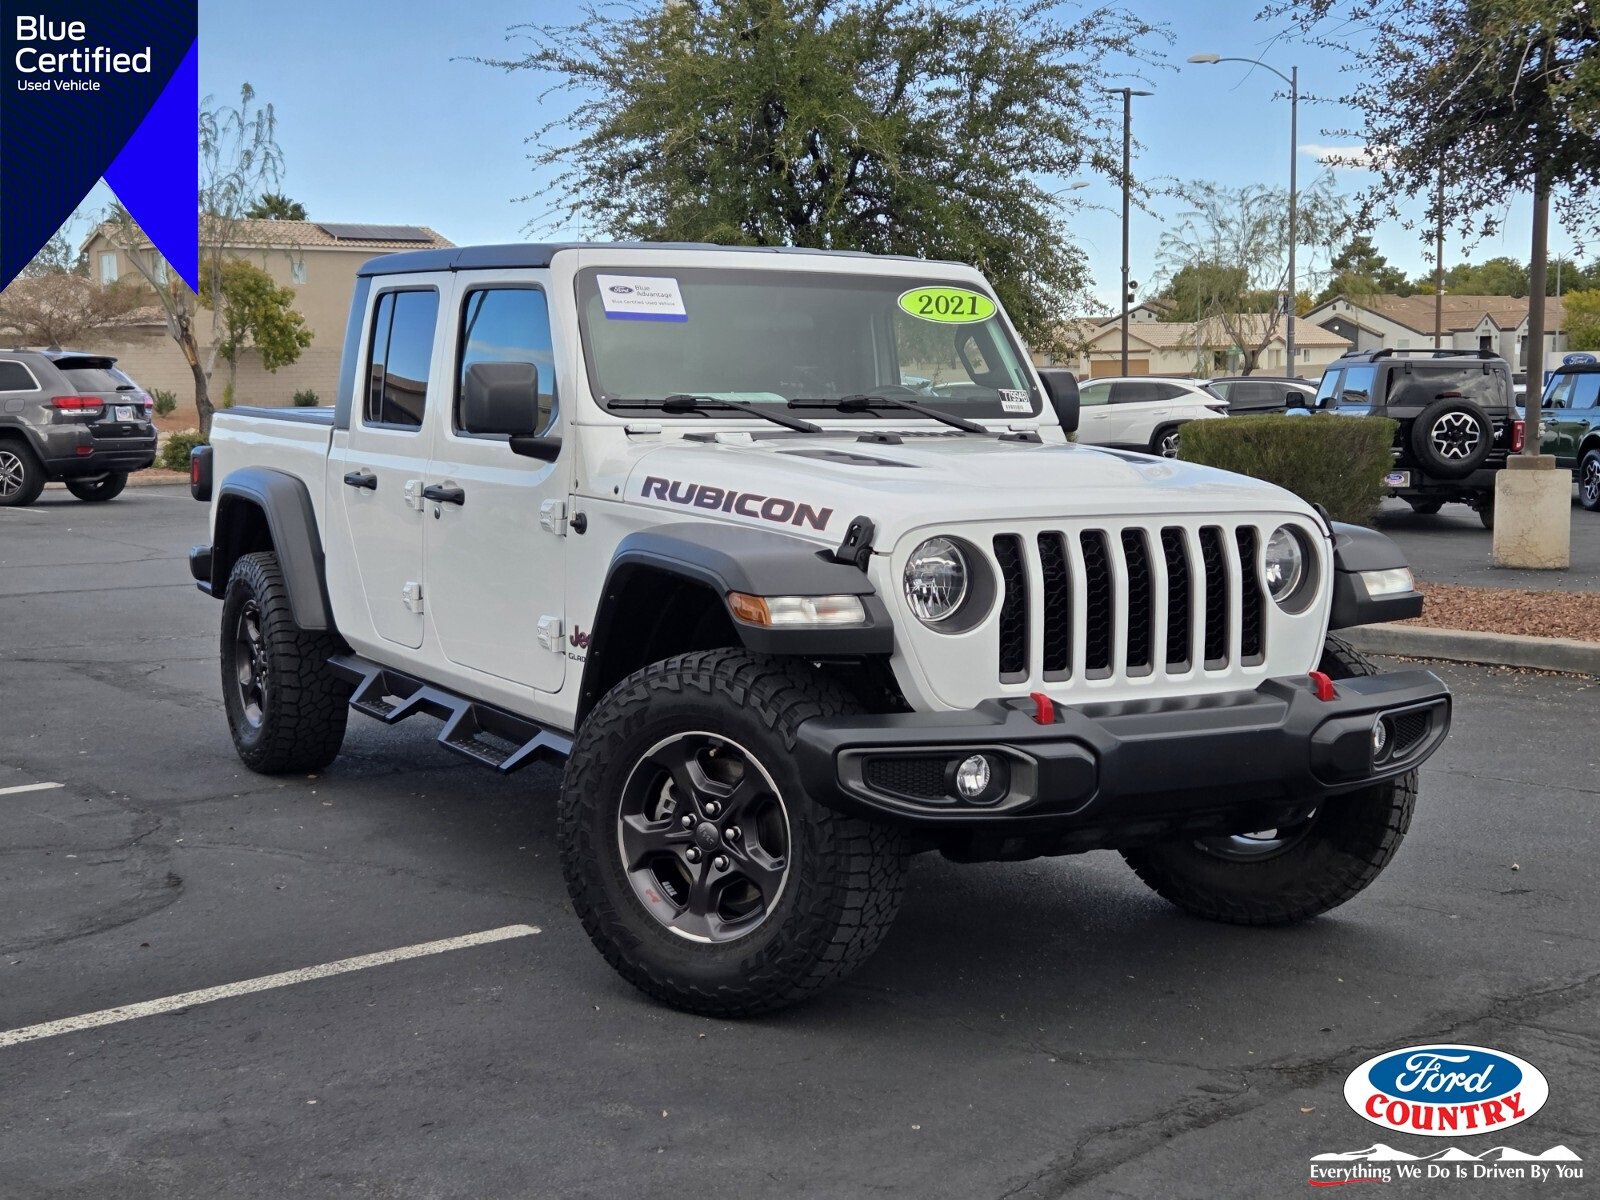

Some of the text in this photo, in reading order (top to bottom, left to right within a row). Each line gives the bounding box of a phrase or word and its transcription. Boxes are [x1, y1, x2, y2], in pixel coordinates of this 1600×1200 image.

[637, 291, 672, 299] Advantage
[918, 295, 979, 315] 2021
[641, 476, 833, 531] RUBICON
